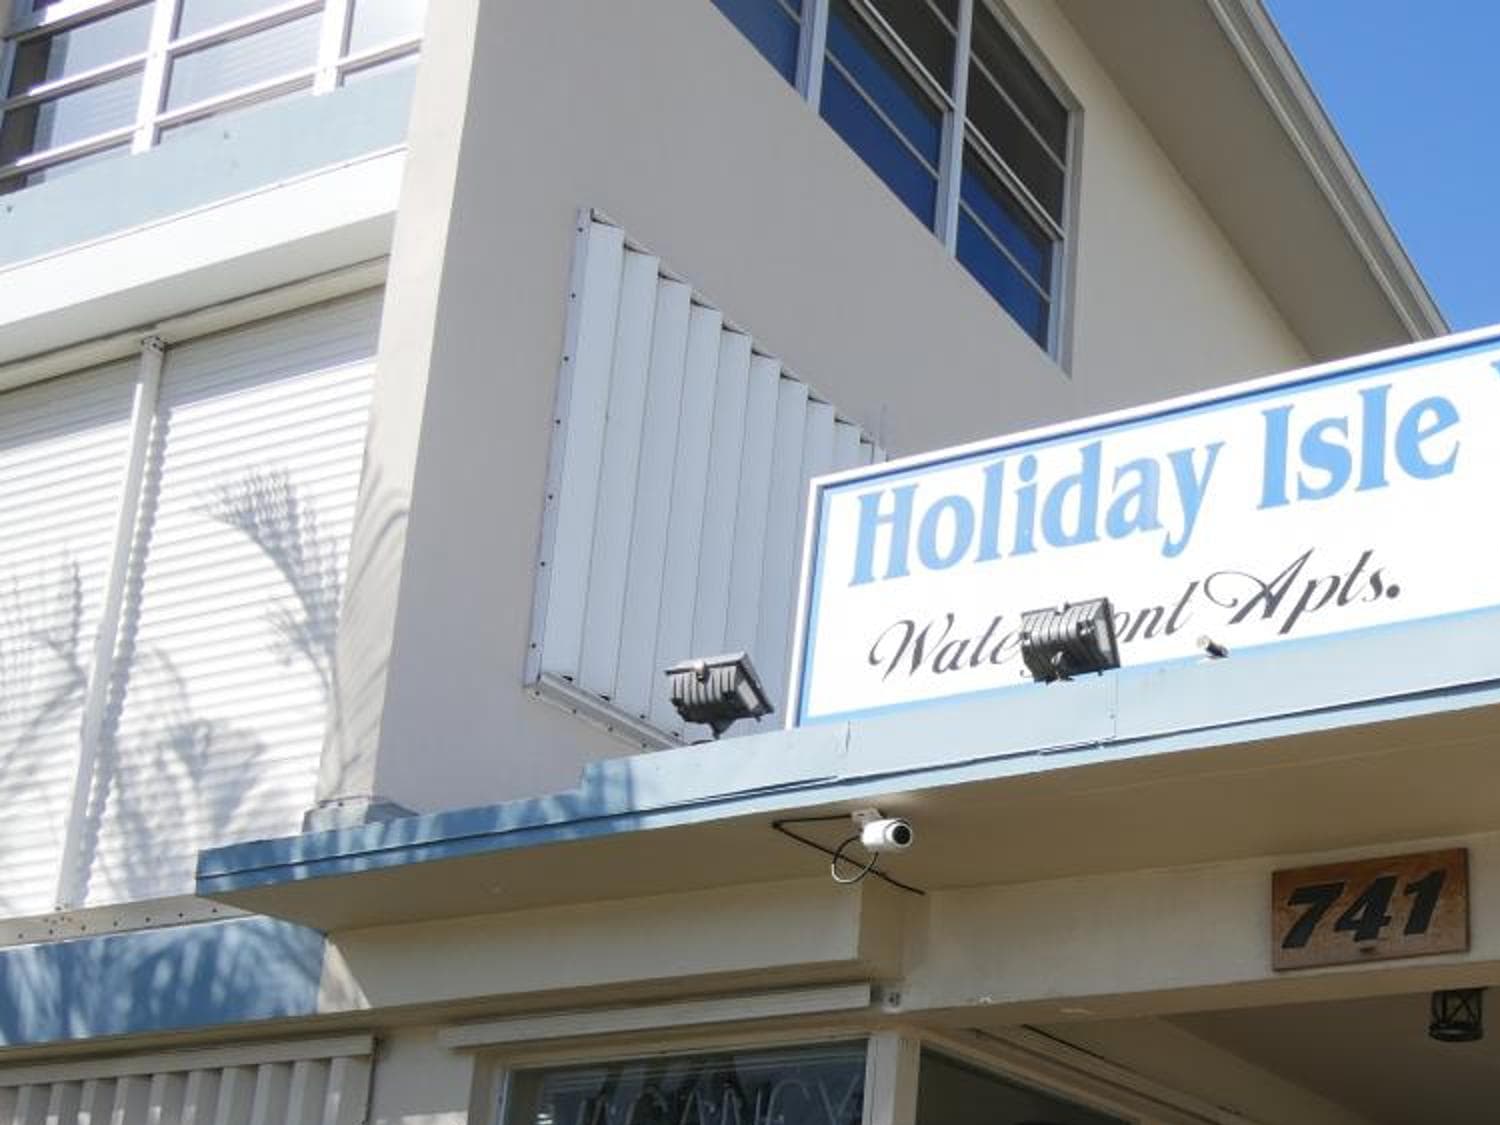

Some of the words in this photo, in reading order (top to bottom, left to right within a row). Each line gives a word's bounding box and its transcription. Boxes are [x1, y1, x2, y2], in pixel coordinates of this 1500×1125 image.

[848, 440, 1226, 587] Holiday
[1256, 384, 1461, 510] Isle
[868, 580, 1200, 682] Wateont
[1203, 547, 1401, 635] Apts.
[1281, 868, 1447, 949] 741
